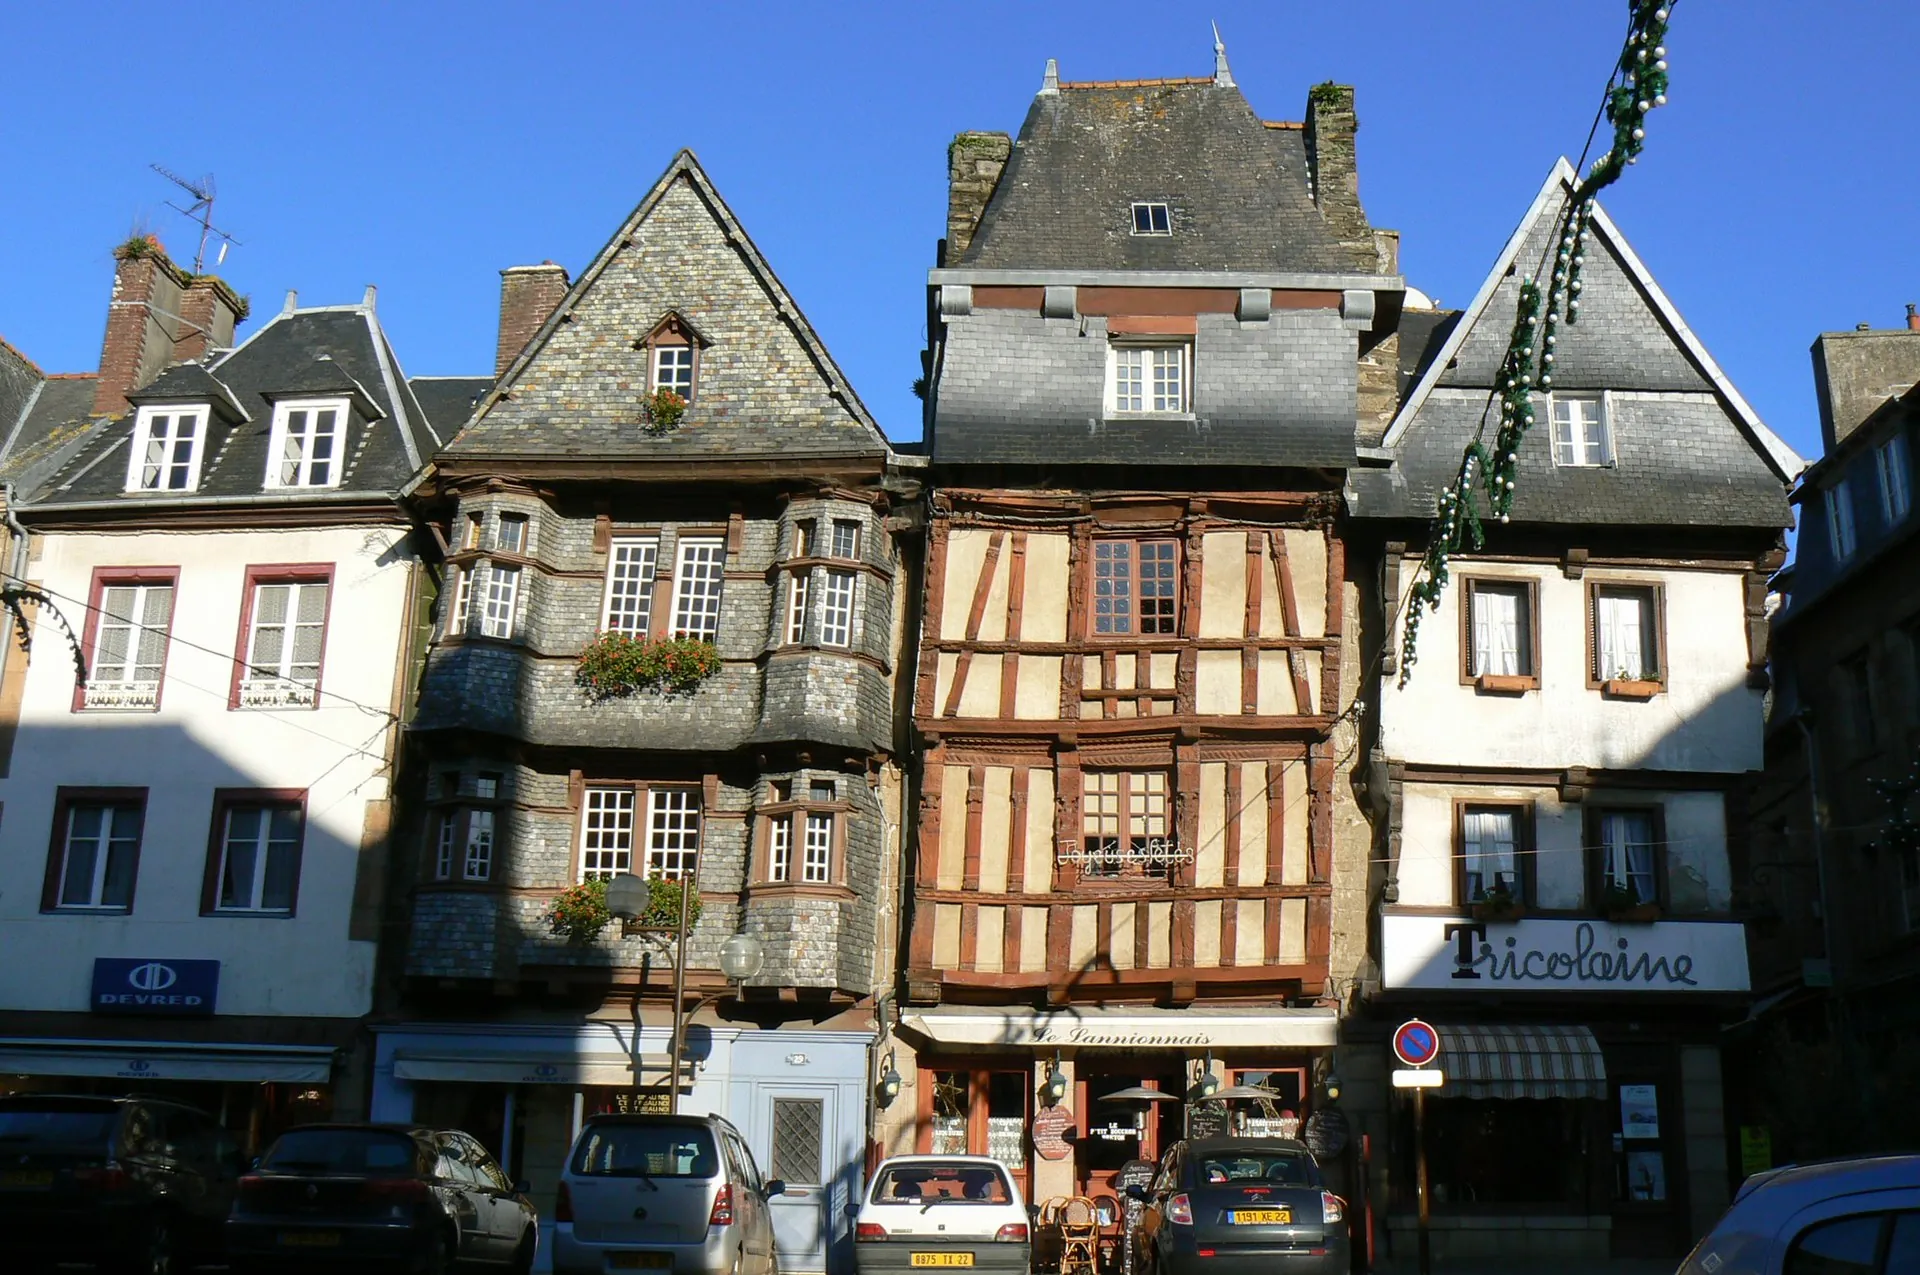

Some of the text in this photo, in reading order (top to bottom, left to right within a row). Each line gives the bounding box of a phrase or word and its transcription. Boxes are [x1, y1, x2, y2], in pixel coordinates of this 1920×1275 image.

[1444, 922, 1698, 986] Tricolaine
[99, 993, 203, 1006] DEVRED
[1029, 1027, 1214, 1044] Le Lannionnais
[1236, 1212, 1287, 1222] 1191 XE 22
[957, 1254, 968, 1265] 22
